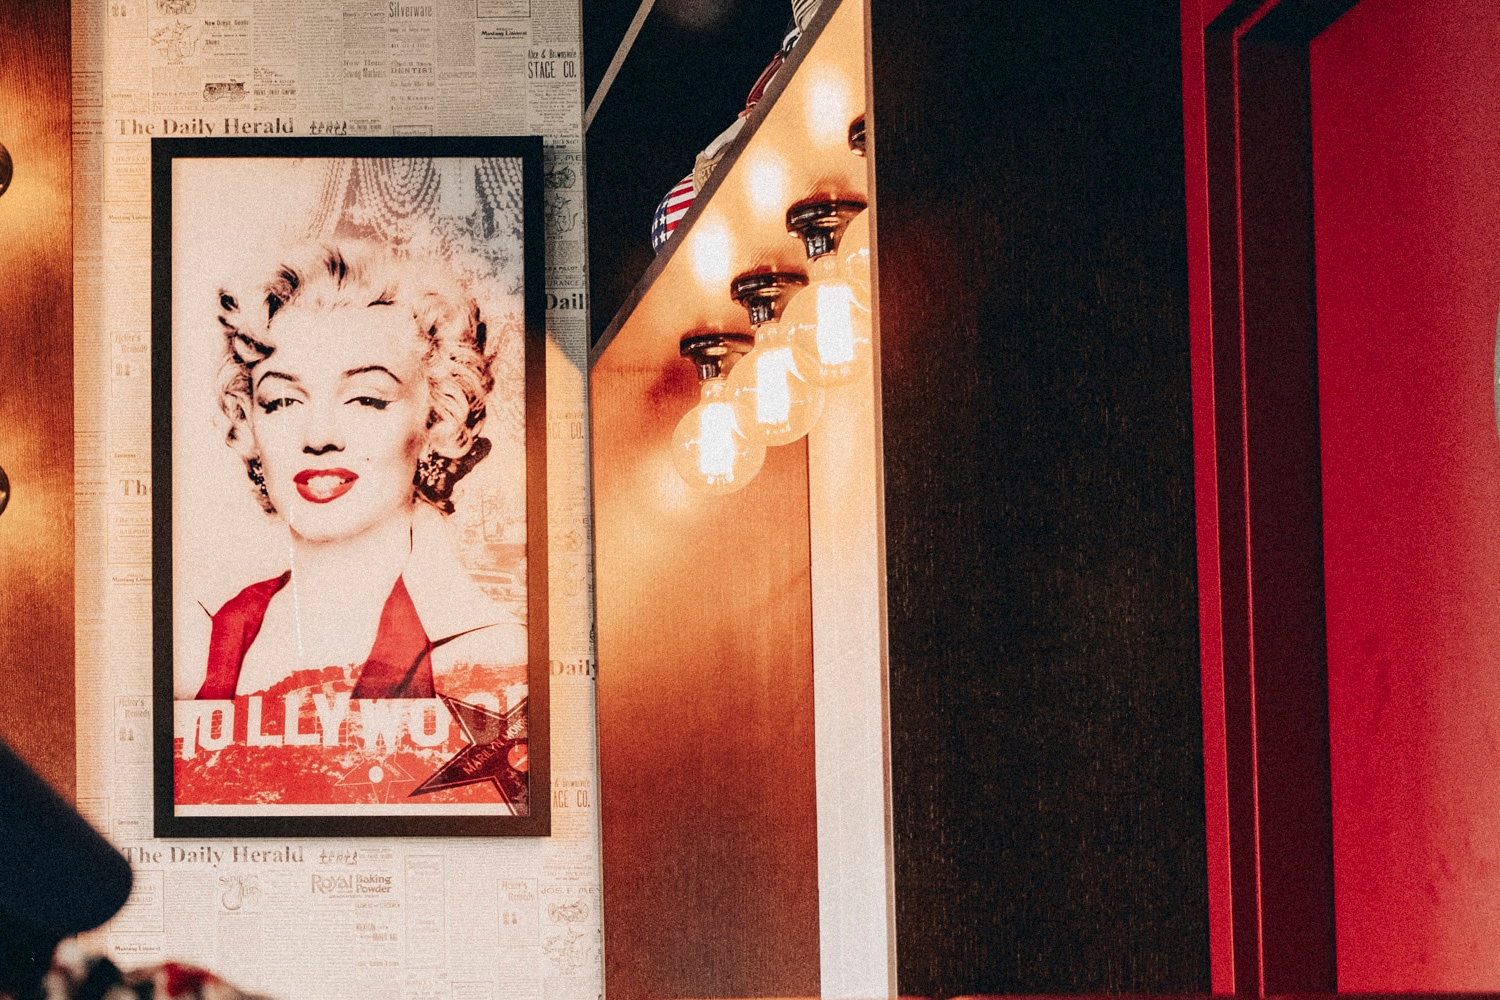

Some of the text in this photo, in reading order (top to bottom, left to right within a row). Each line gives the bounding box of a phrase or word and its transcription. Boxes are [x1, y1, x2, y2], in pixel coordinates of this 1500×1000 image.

[389, 1, 433, 18] Silverware
[563, 60, 577, 78] CO.
[115, 117, 294, 137] The Daily Herald
[119, 479, 152, 496] Th
[461, 738, 506, 776] MARILYN
[576, 789, 591, 808] CO.
[122, 845, 304, 868] The Daily Herald
[310, 873, 353, 894] Royal
[355, 873, 392, 884] Baking
[355, 884, 392, 894] Powder
